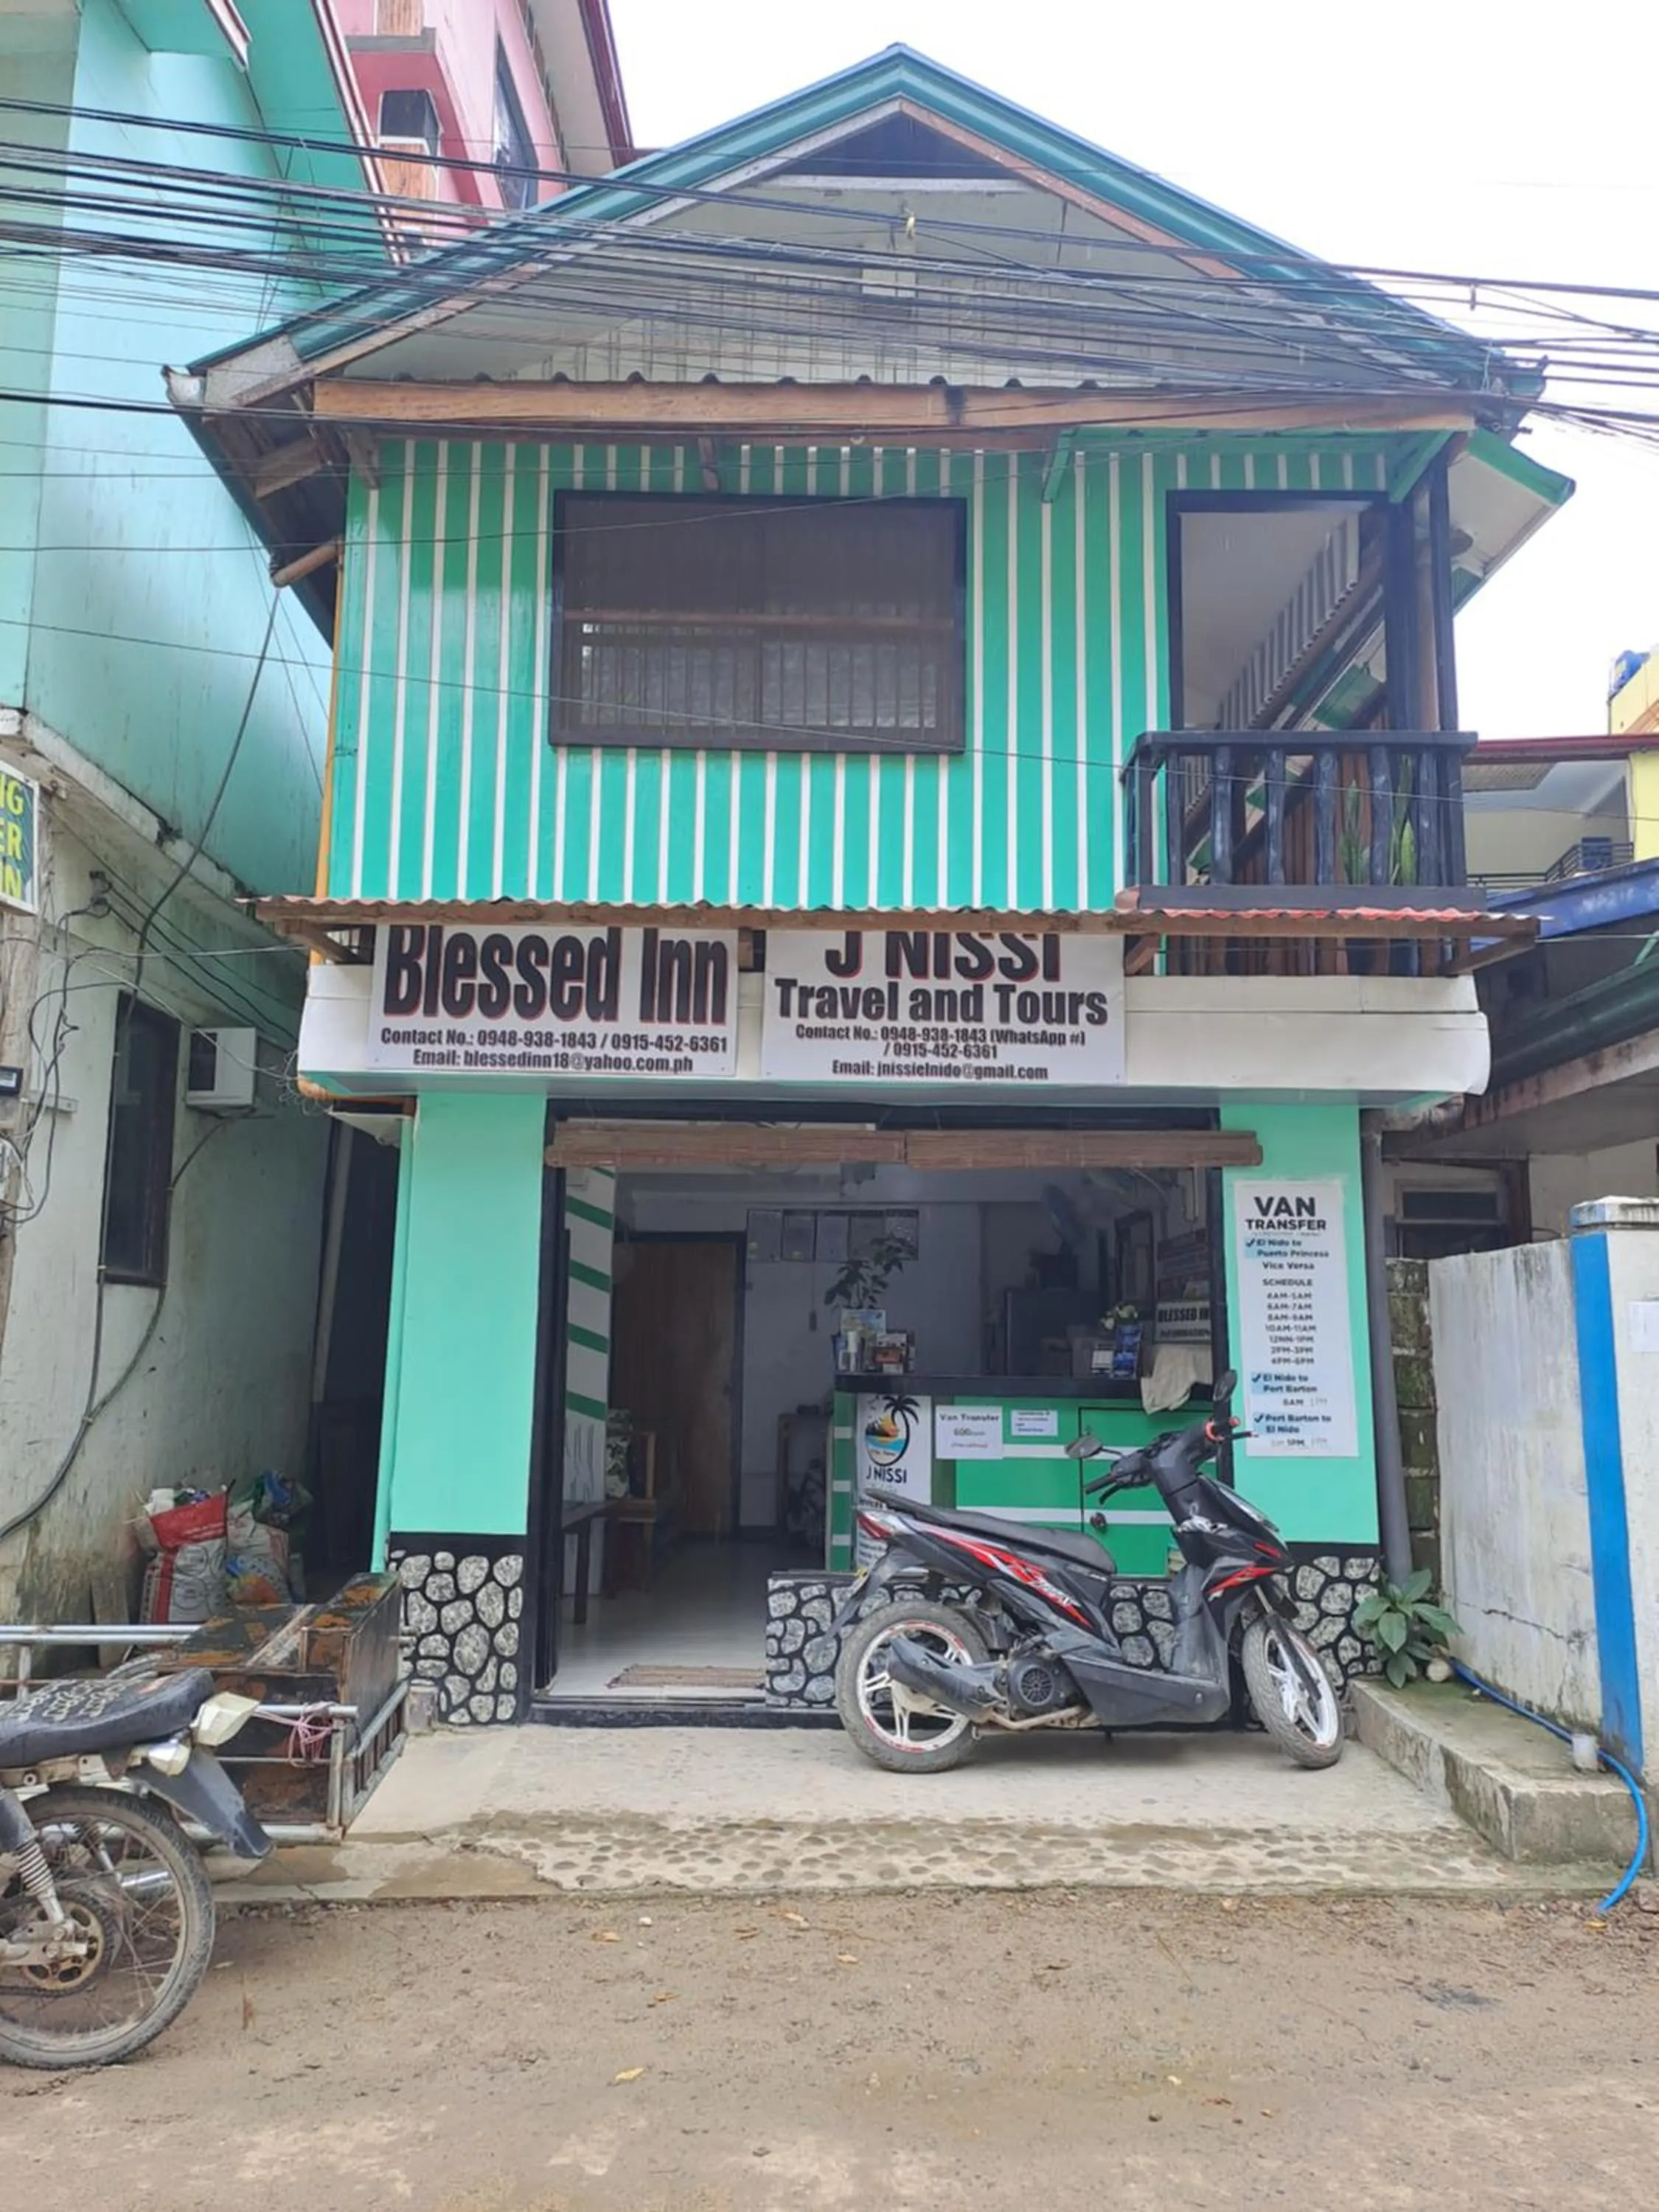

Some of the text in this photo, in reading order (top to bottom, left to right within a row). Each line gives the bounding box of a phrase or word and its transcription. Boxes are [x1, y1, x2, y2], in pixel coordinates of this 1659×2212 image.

[824, 931, 1062, 982] J NISSI
[383, 925, 728, 1025] Blessed Inn
[774, 978, 1107, 1025] Travel and Tours
[380, 1027, 727, 1053] Contact No.: 0948-938-1843 / 0915-452-6361
[796, 1023, 849, 1040] Contact
[853, 1026, 878, 1041] No.:
[880, 1026, 987, 1043] 0948-938-1843
[990, 1029, 1066, 1047] (WhatsApp
[413, 1048, 693, 1074] Email: blessedinn18@yahoo.com.ph
[893, 1043, 998, 1060] 0915-452-6361
[832, 1059, 874, 1076] Email:
[1253, 1196, 1315, 1217] VAN
[1245, 1218, 1326, 1231] TRANSFER
[1262, 1279, 1313, 1287] SCHEDULE
[874, 1467, 908, 1484] NISSI
